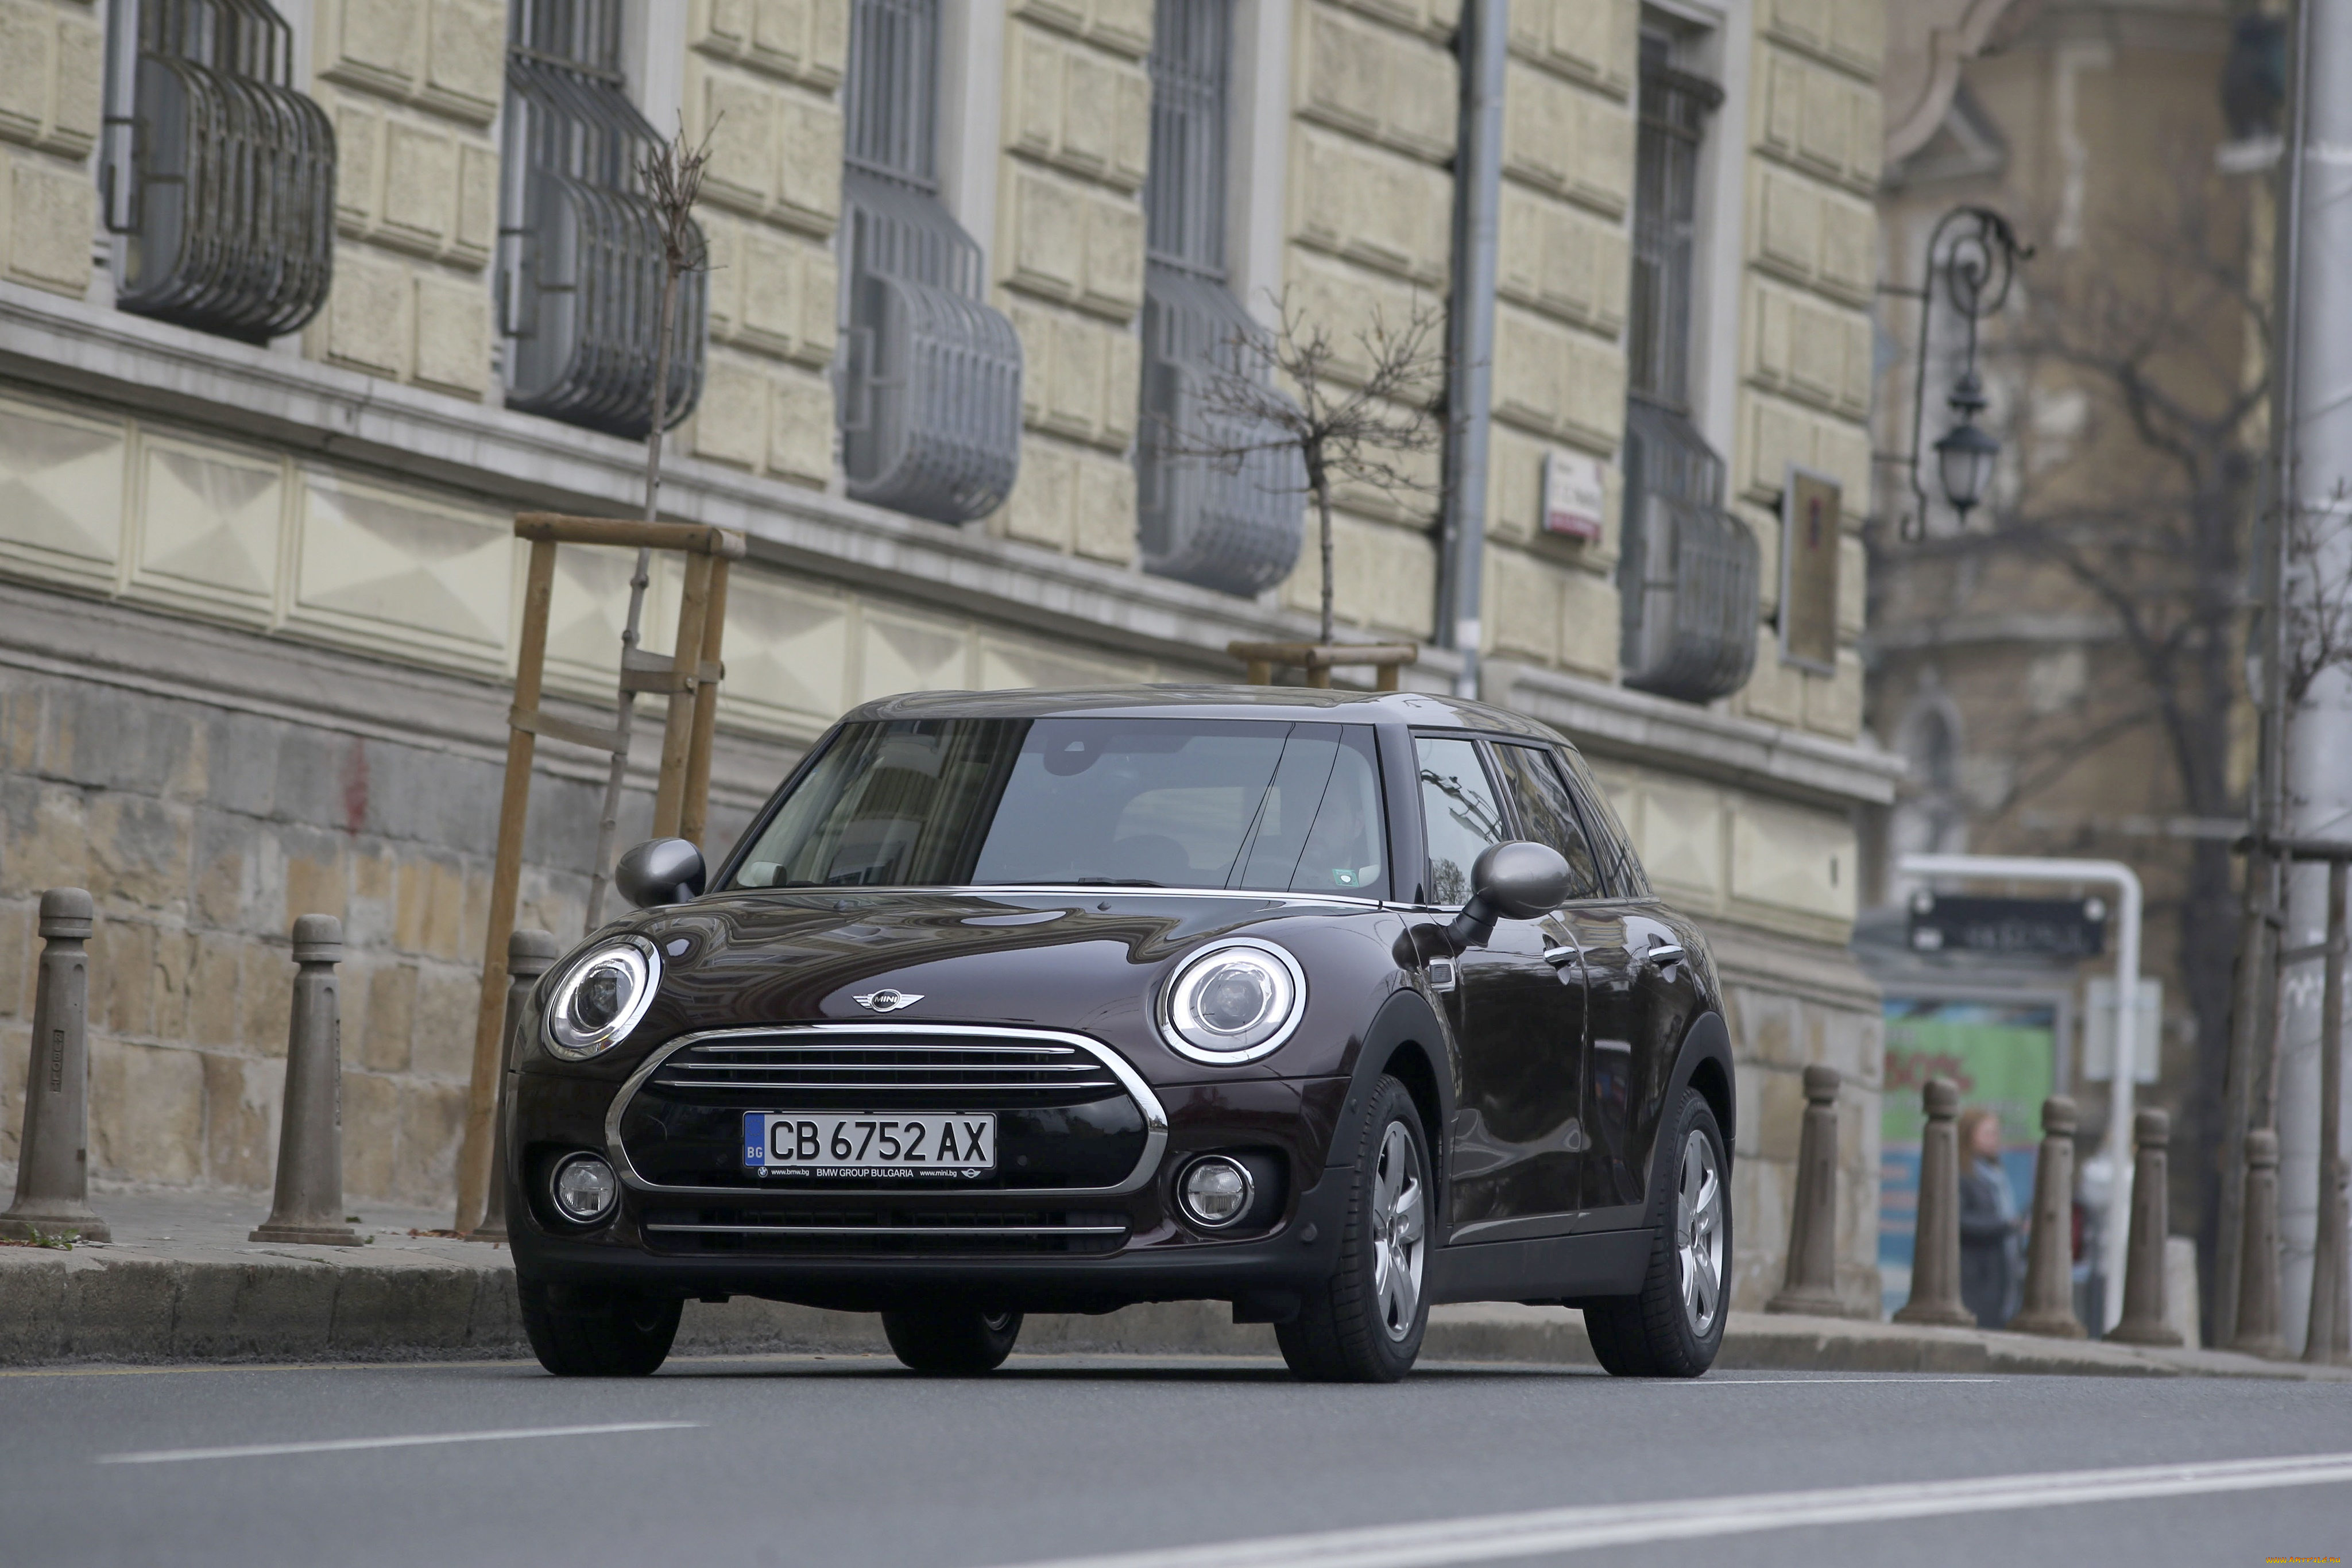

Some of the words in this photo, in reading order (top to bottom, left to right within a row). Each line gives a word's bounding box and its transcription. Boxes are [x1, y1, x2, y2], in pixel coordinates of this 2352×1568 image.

[770, 1121, 820, 1160] CB
[830, 1121, 927, 1161] 6752
[937, 1121, 988, 1162] AX
[747, 1147, 763, 1159] BG
[817, 1169, 838, 1177] BMW
[840, 1169, 869, 1177] GROUP
[871, 1169, 914, 1178] BULGARIA
